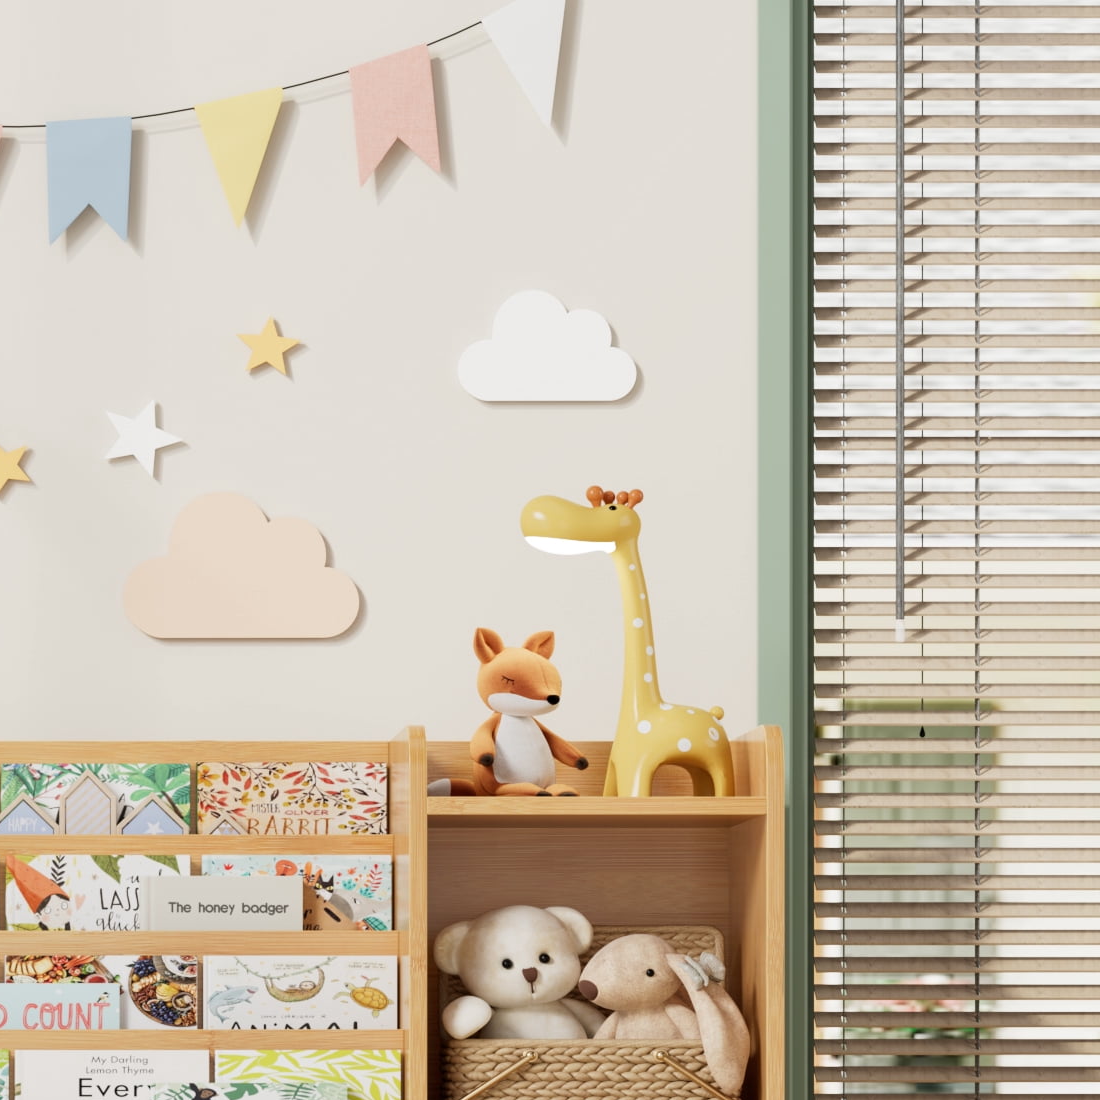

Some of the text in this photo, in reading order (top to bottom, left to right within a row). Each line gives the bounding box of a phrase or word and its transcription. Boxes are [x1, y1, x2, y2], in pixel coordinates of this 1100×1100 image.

[7, 818, 38, 833] HAPPY
[99, 886, 140, 912] LASS
[168, 902, 192, 914] The
[198, 902, 236, 916] honey
[241, 902, 290, 916] badger
[21, 1001, 111, 1030] COUNT
[91, 1055, 149, 1066] My Darling
[85, 1066, 154, 1076] Lemon Thyme
[78, 1078, 152, 1099] Ever
